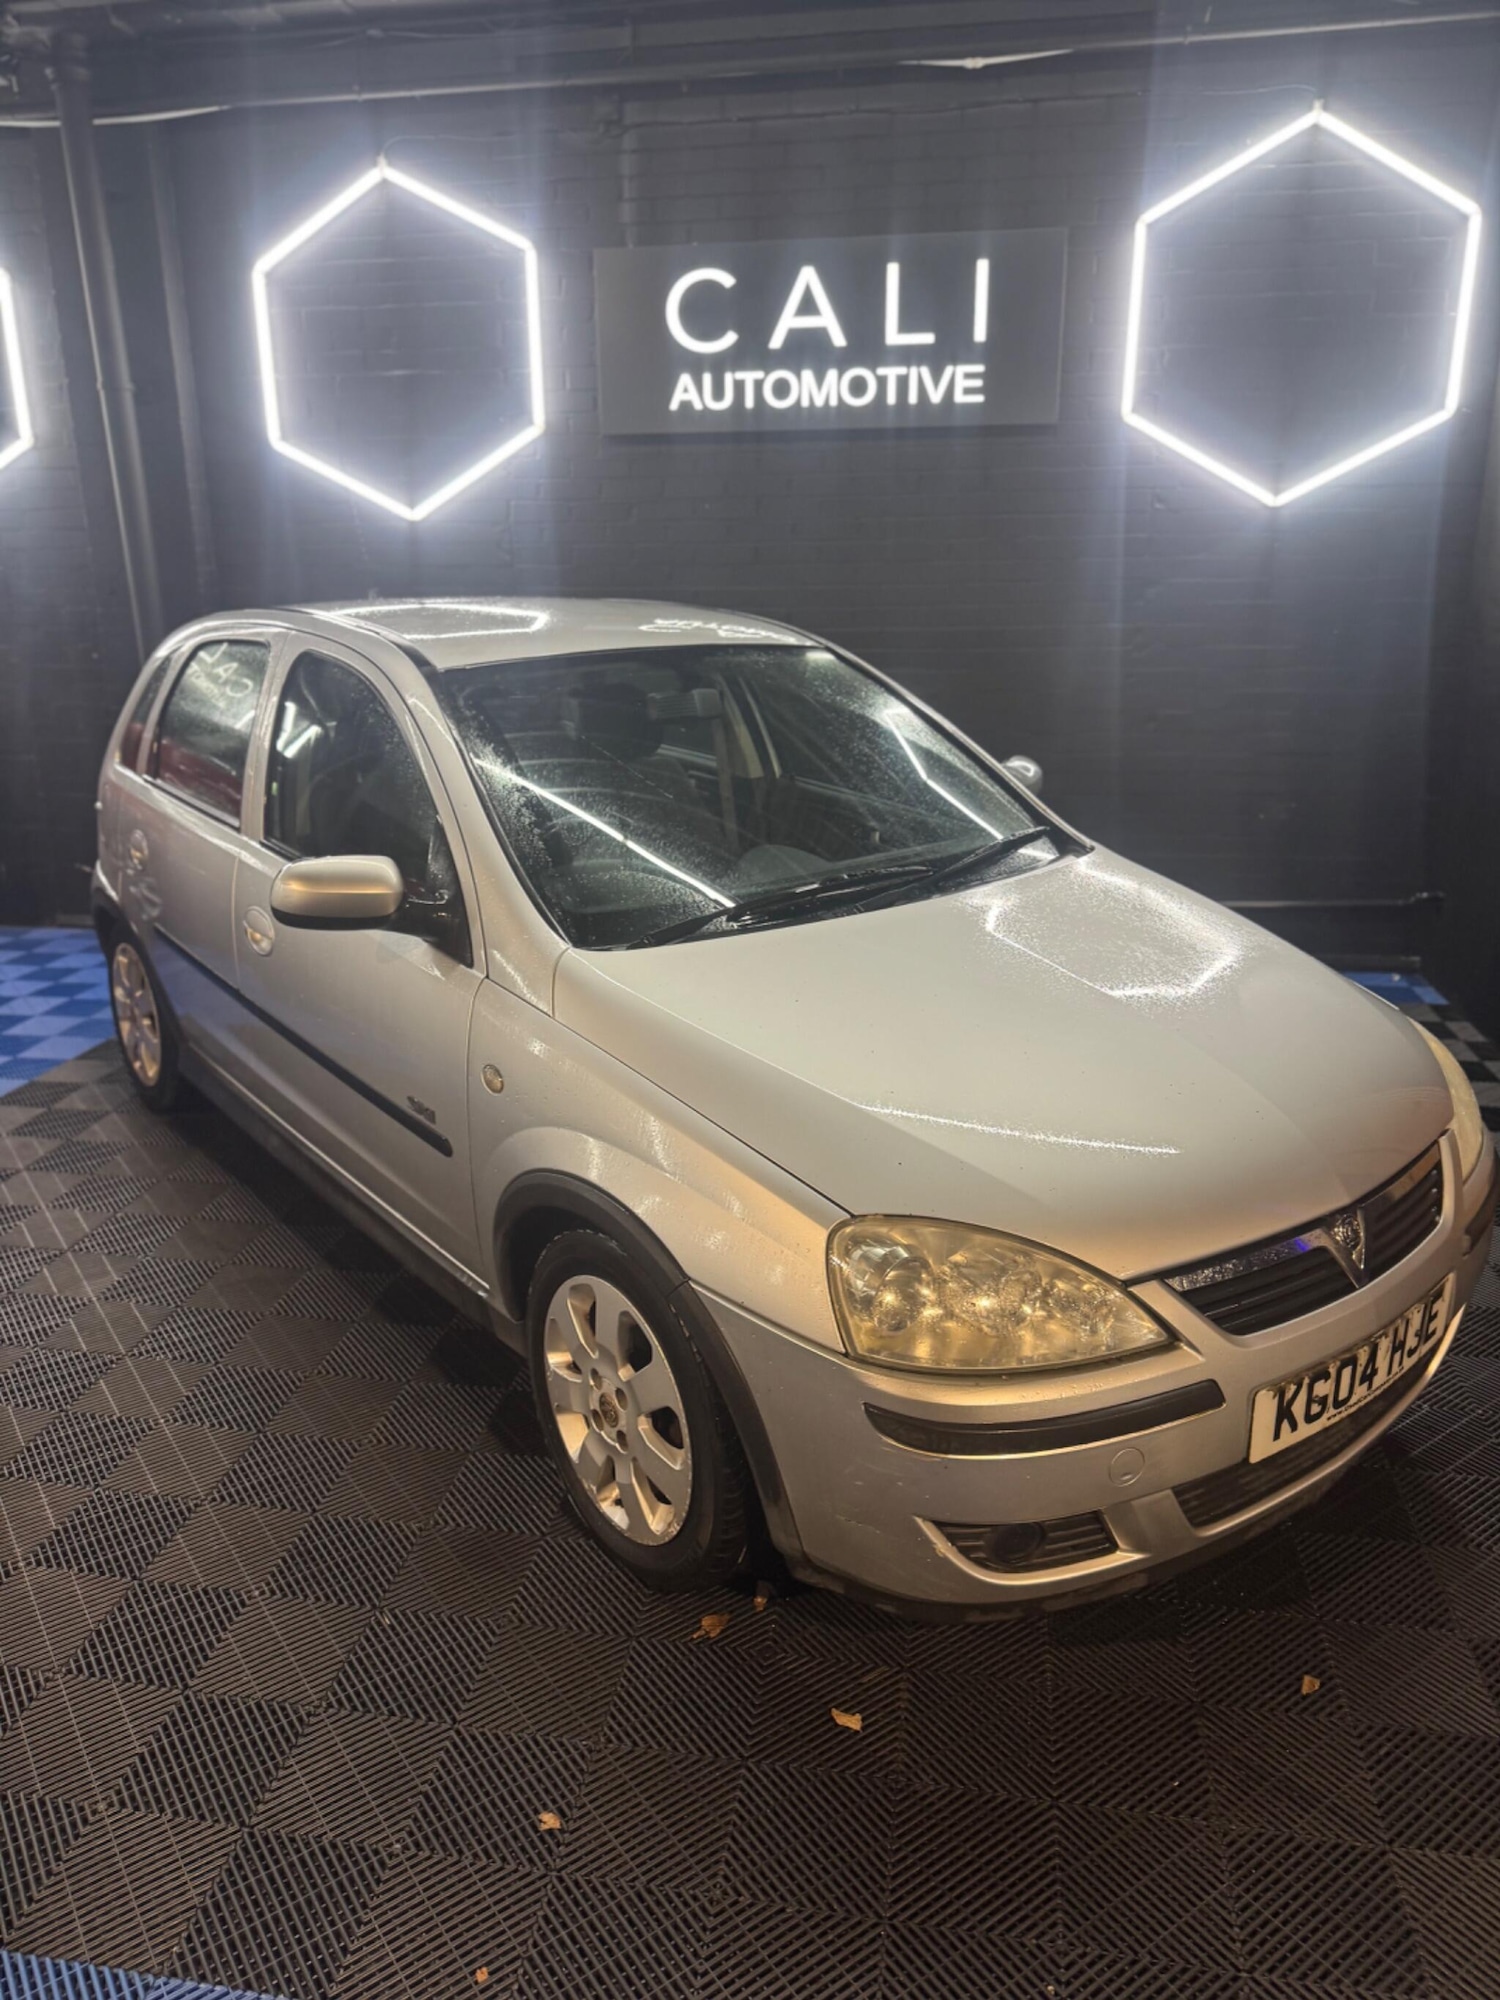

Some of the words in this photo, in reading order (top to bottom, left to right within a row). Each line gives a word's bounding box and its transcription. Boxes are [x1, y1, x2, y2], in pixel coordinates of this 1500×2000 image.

[665, 258, 989, 354] CALI
[668, 364, 986, 411] AUTOMOTIVE
[1273, 1342, 1379, 1442] KG04
